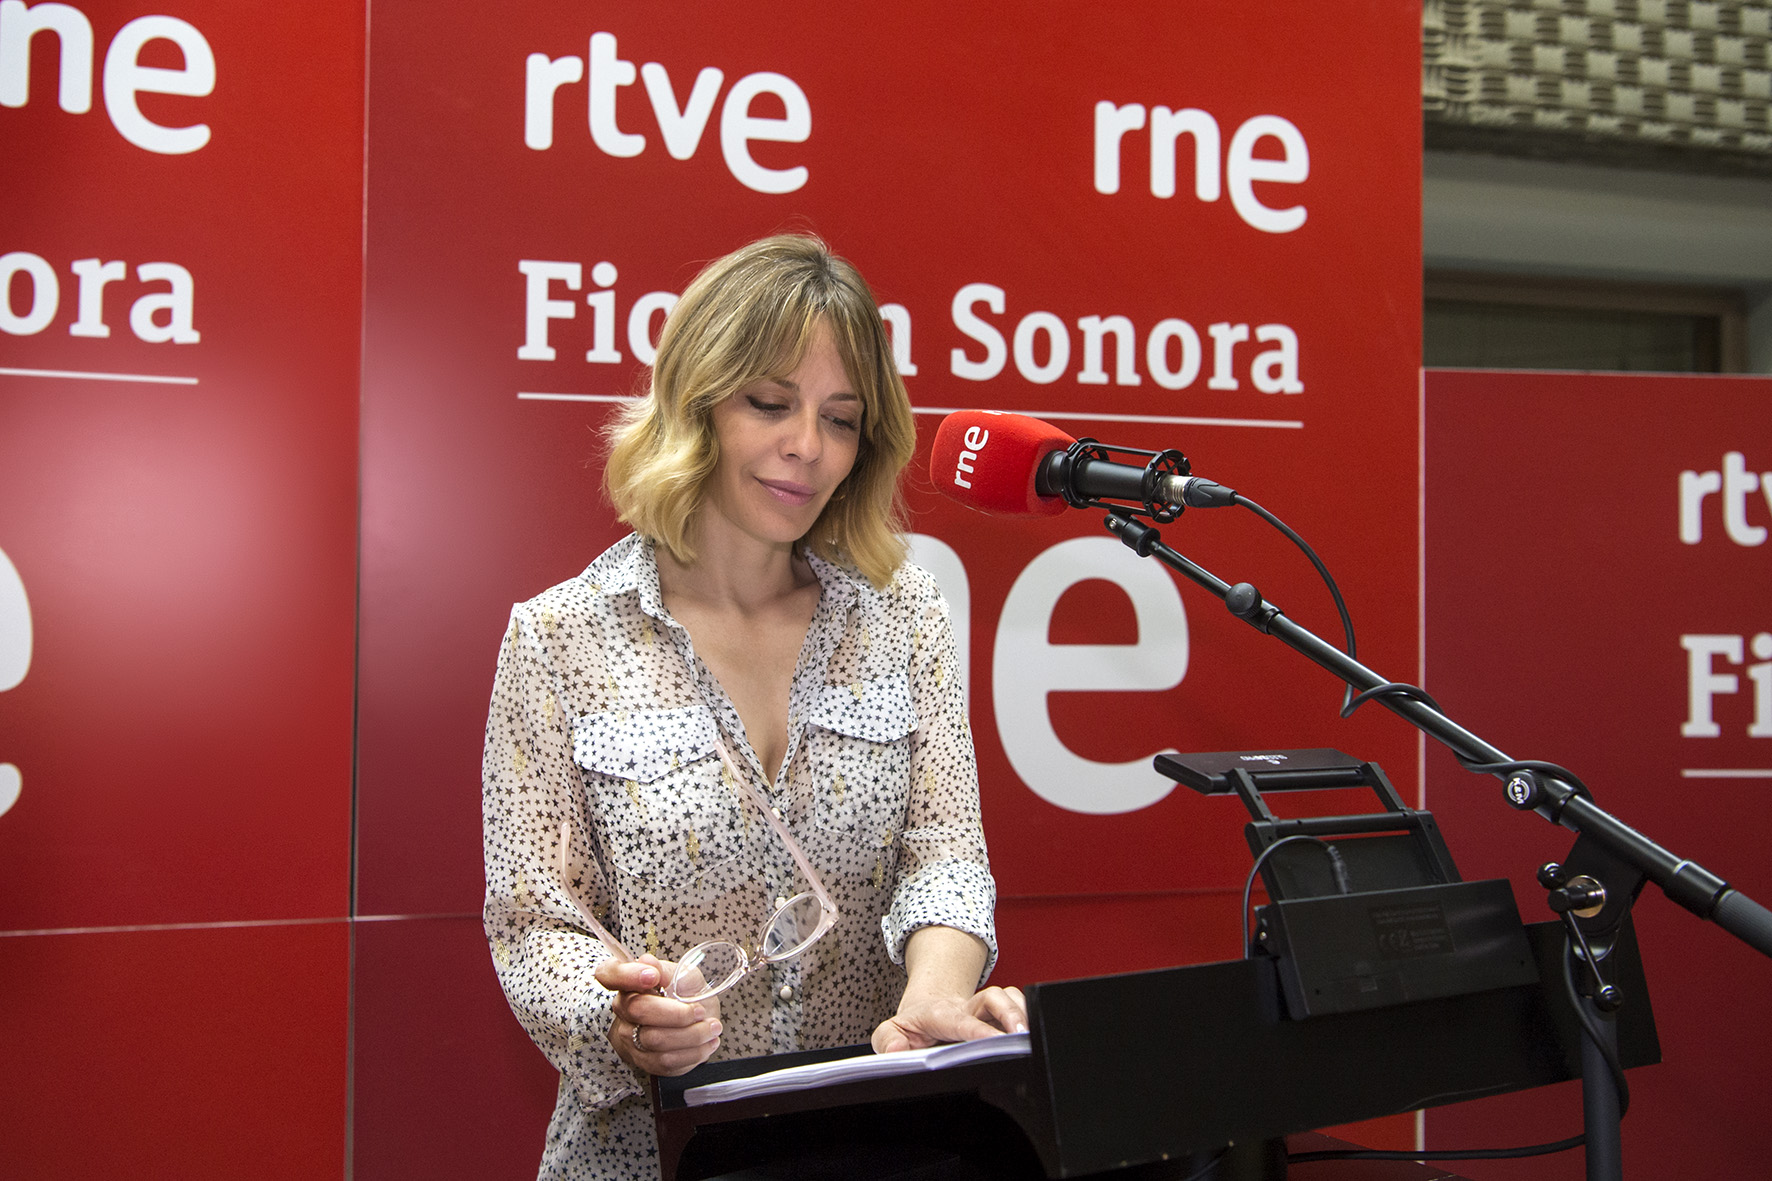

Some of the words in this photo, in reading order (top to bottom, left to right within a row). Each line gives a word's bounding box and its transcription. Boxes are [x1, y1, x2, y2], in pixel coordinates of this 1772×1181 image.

[524, 31, 812, 194] rtve
[1094, 100, 1310, 233] rne
[950, 283, 1304, 394] Sonora
[953, 425, 989, 490] rne
[1679, 451, 1772, 546] rt
[1512, 776, 1526, 805] K&M
